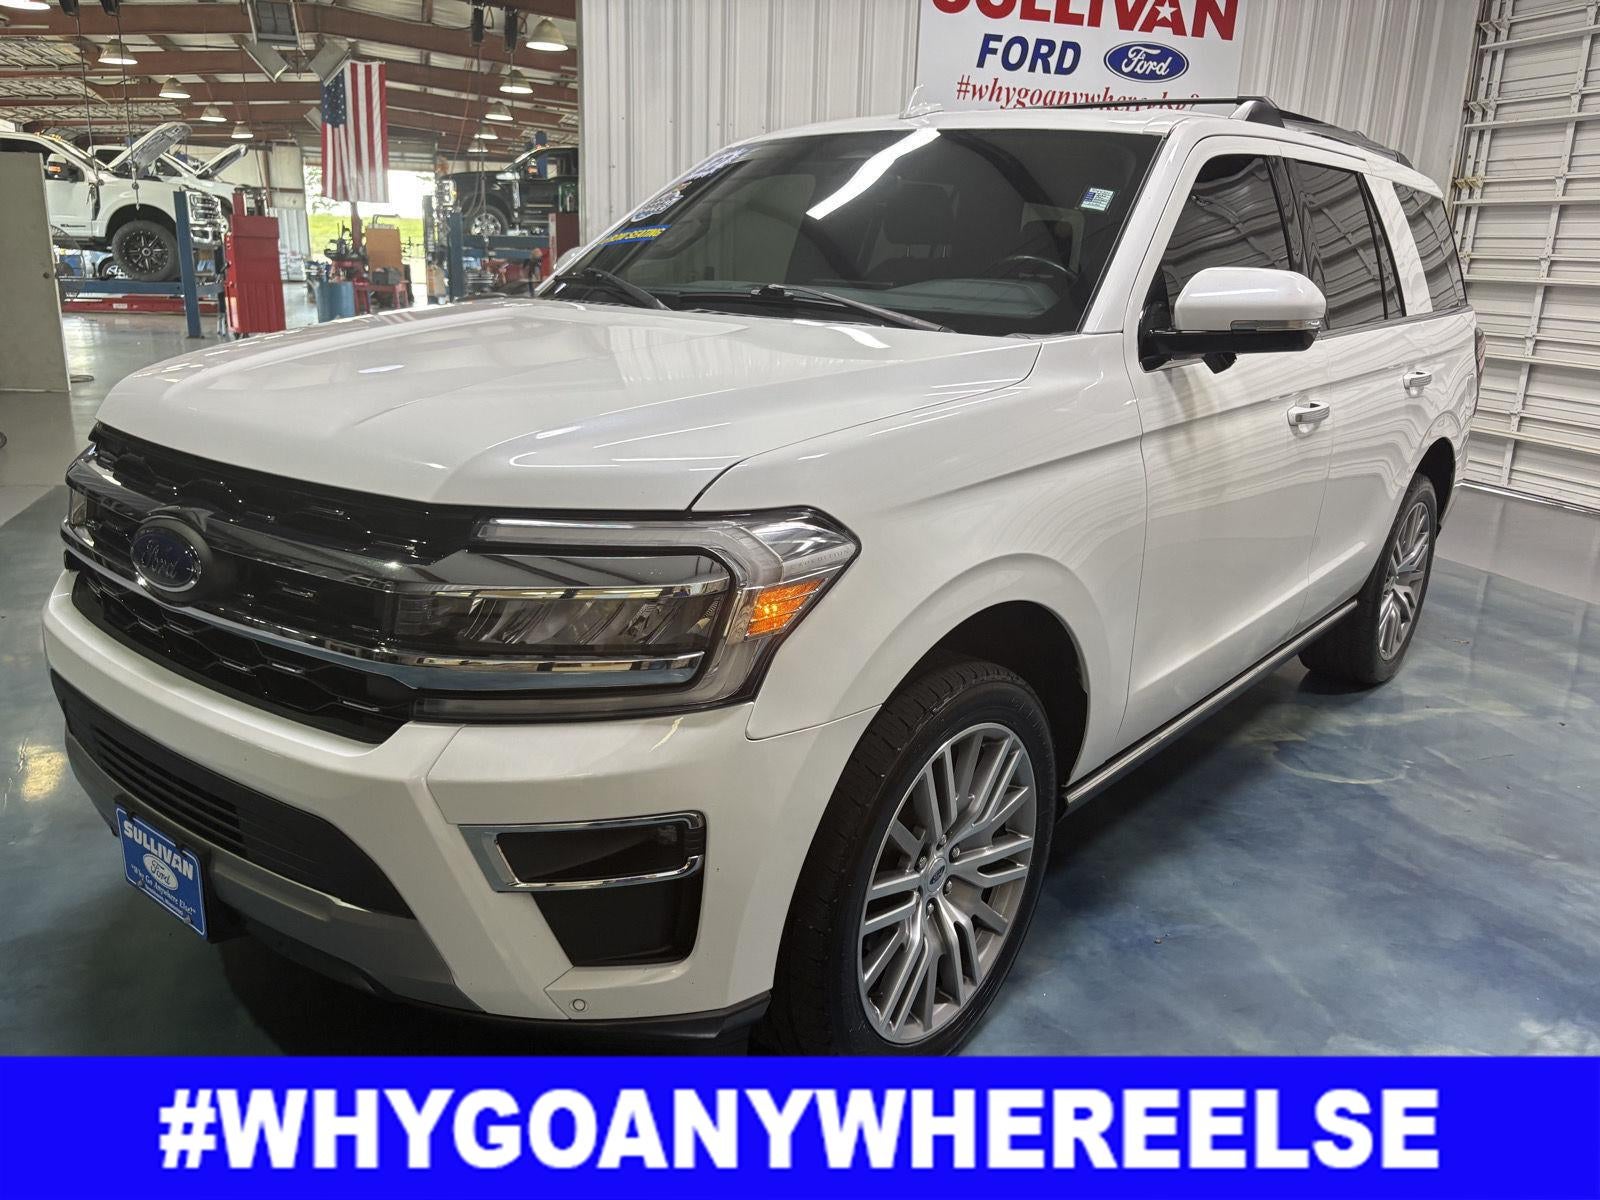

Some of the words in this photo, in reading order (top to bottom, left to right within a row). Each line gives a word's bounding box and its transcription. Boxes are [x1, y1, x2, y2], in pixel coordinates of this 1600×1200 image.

[976, 33, 1082, 76] FORD
[1122, 46, 1170, 75] Ford
[123, 819, 194, 881] SULLIVAN
[150, 858, 172, 886] Ford
